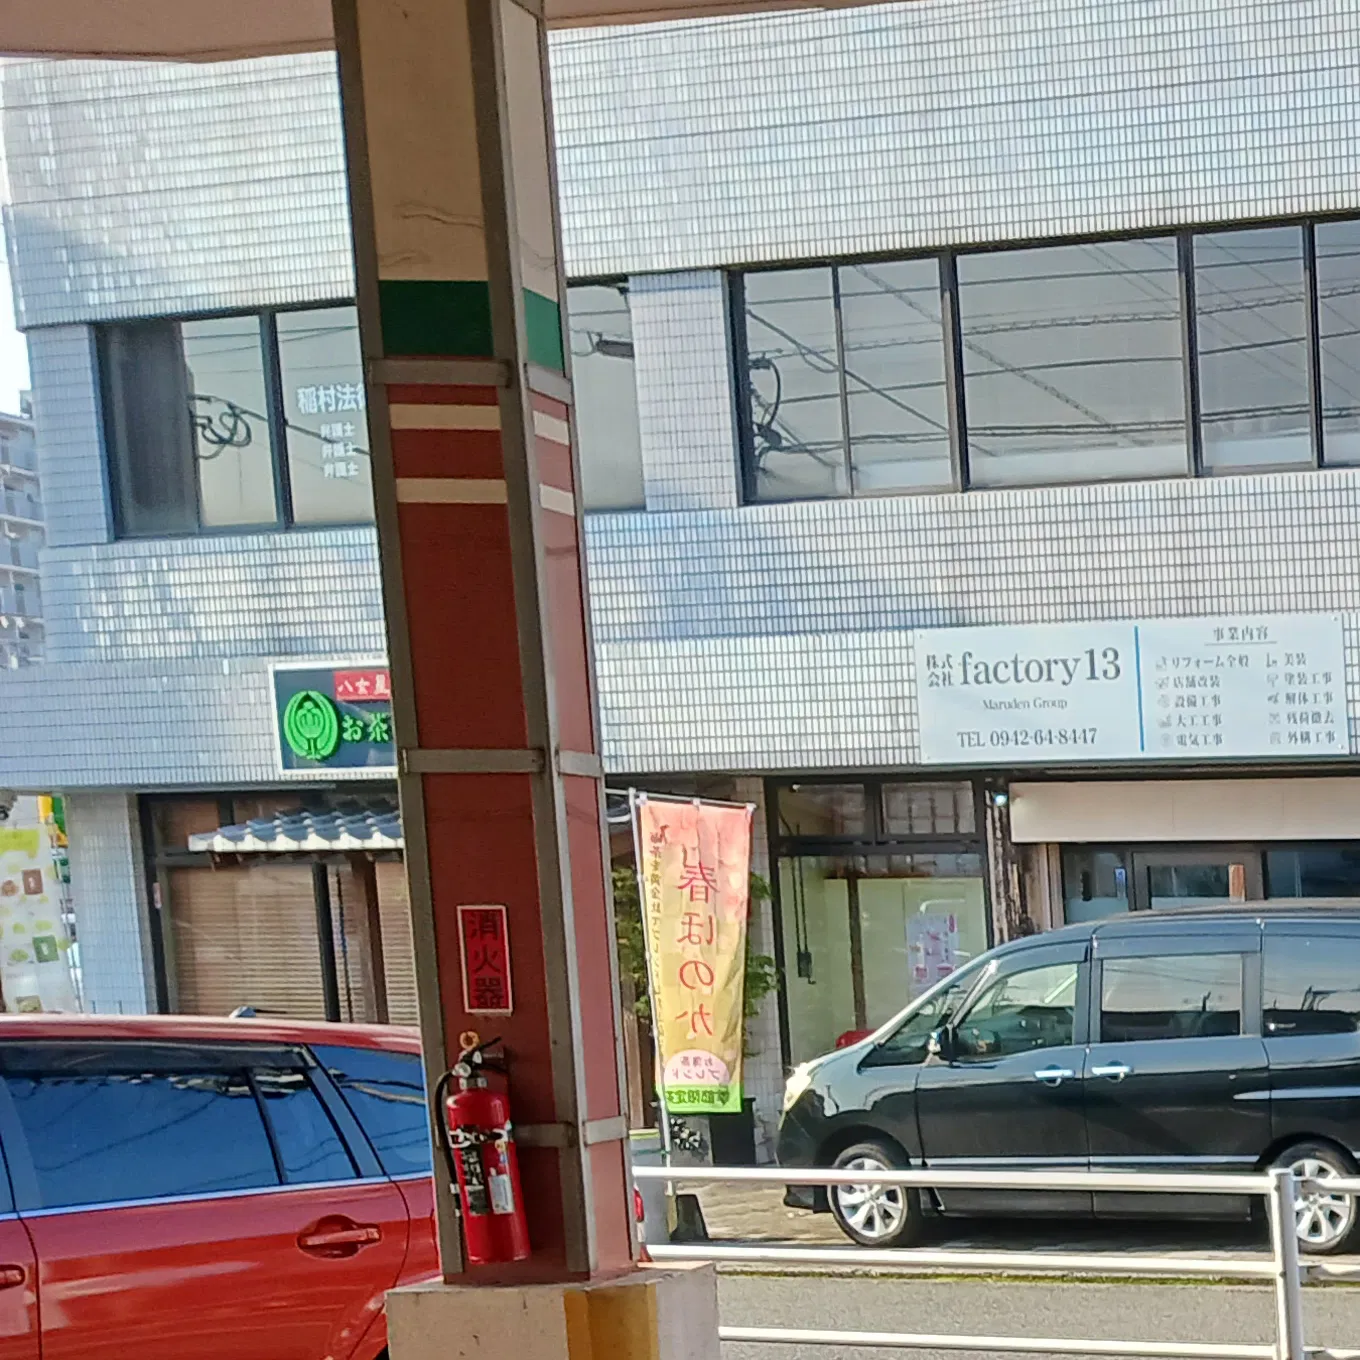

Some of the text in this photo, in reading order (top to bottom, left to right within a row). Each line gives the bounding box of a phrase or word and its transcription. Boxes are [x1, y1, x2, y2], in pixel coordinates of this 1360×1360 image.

[1213, 626, 1269, 642] 事業内容
[926, 653, 954, 670] 株式
[927, 671, 954, 688] 会社
[982, 697, 1068, 711] Maruden Group
[342, 711, 390, 742] お茶
[957, 731, 985, 749] TEL
[469, 909, 504, 1009] 消火器
